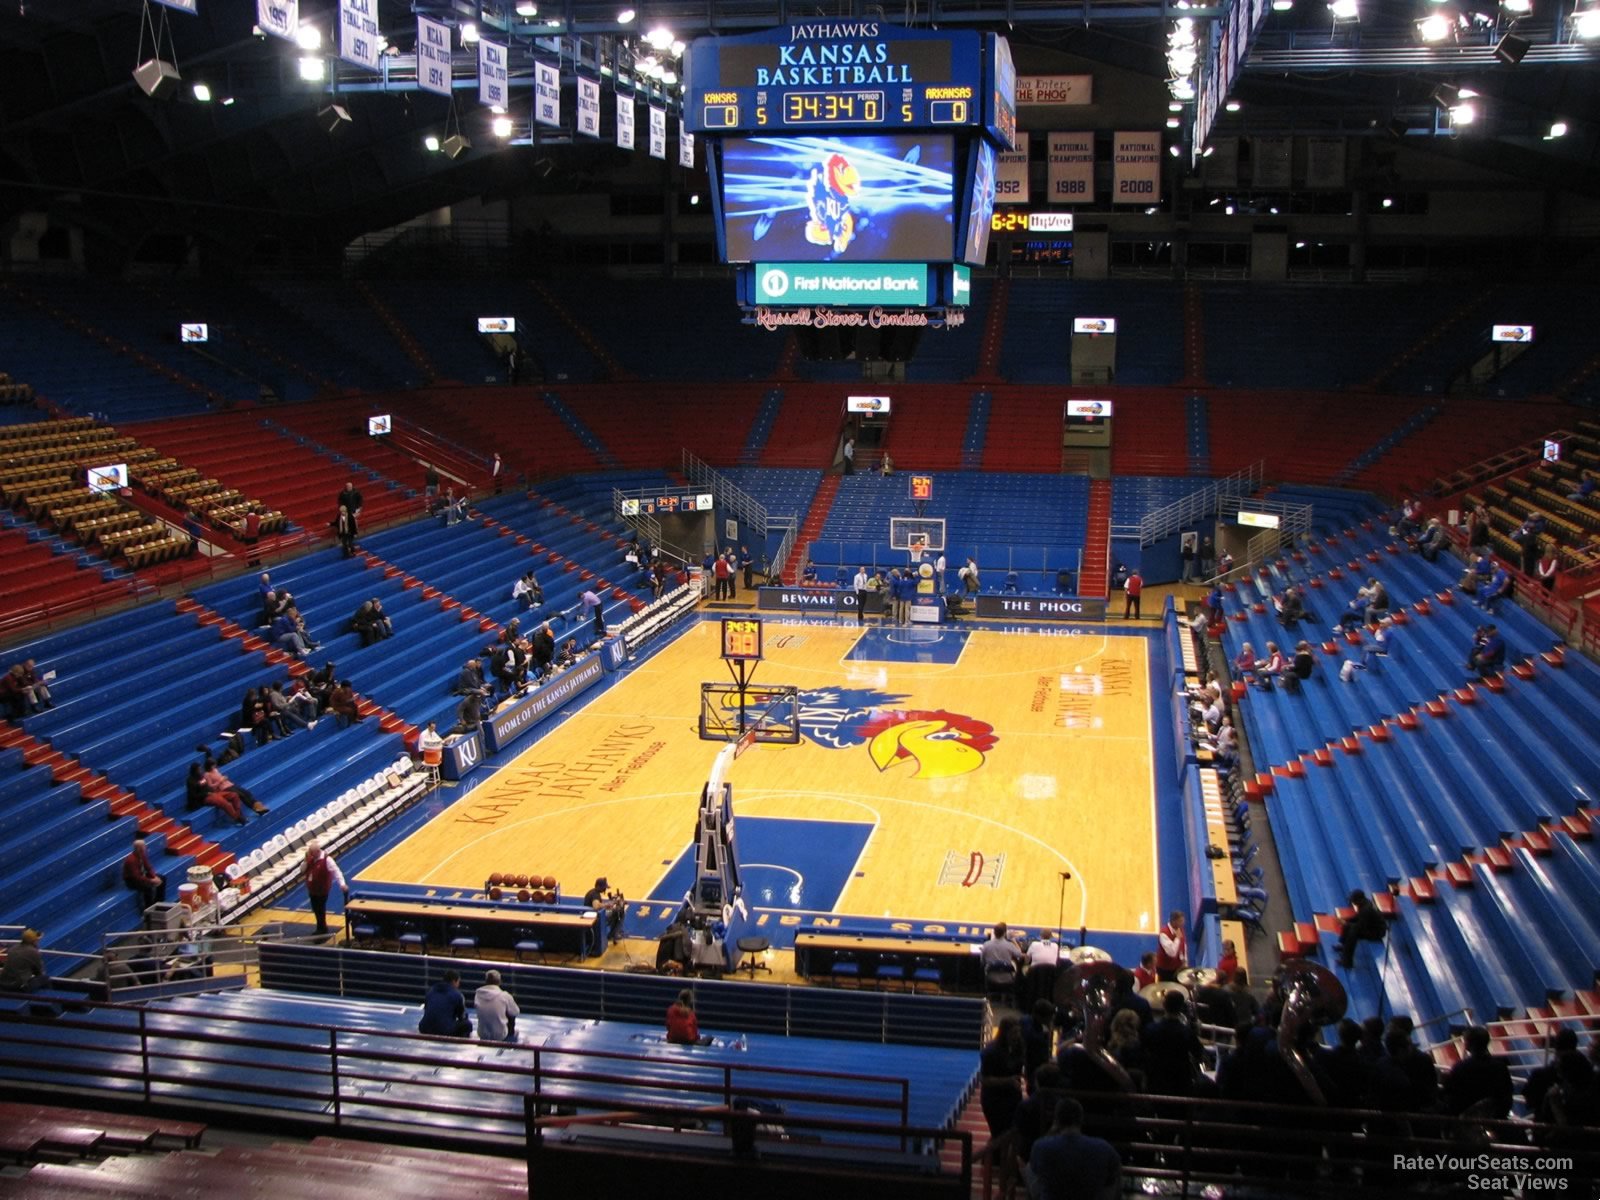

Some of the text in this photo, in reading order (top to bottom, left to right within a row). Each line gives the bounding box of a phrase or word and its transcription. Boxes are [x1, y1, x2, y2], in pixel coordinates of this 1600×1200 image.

[791, 23, 878, 42] JAYHAWKS
[354, 38, 368, 59] 1971
[780, 44, 887, 66] KANSAS
[429, 67, 443, 86] 1974
[757, 65, 913, 86] BASKETBALL
[704, 92, 737, 104] KANSAS
[925, 87, 972, 99] ARKANSAS
[725, 106, 736, 126] 0
[790, 95, 853, 119] 34:34
[865, 101, 876, 120] 0
[953, 102, 965, 121] 0
[1054, 143, 1088, 151] NATIONAL
[1120, 143, 1155, 151] NATIONAL
[1050, 155, 1093, 163] CHAMPIONS
[1116, 155, 1159, 163] CHAMPIONS
[996, 180, 1020, 193] 952
[1056, 180, 1085, 193] 1988
[1120, 180, 1153, 193] 2008
[794, 277, 820, 291] First
[822, 277, 881, 291] National
[883, 277, 919, 291] Bank
[755, 306, 812, 331] Russell
[814, 305, 867, 329] Stover
[869, 305, 928, 329] Candies
[1001, 601, 1082, 612] THE PHOG
[611, 640, 624, 662] KU
[498, 663, 600, 737] HOME OF THE KANSAS JAYHAWKS
[458, 737, 477, 767] KU
[537, 724, 655, 799] JAYHAWKS
[454, 761, 567, 824] KANSAS
